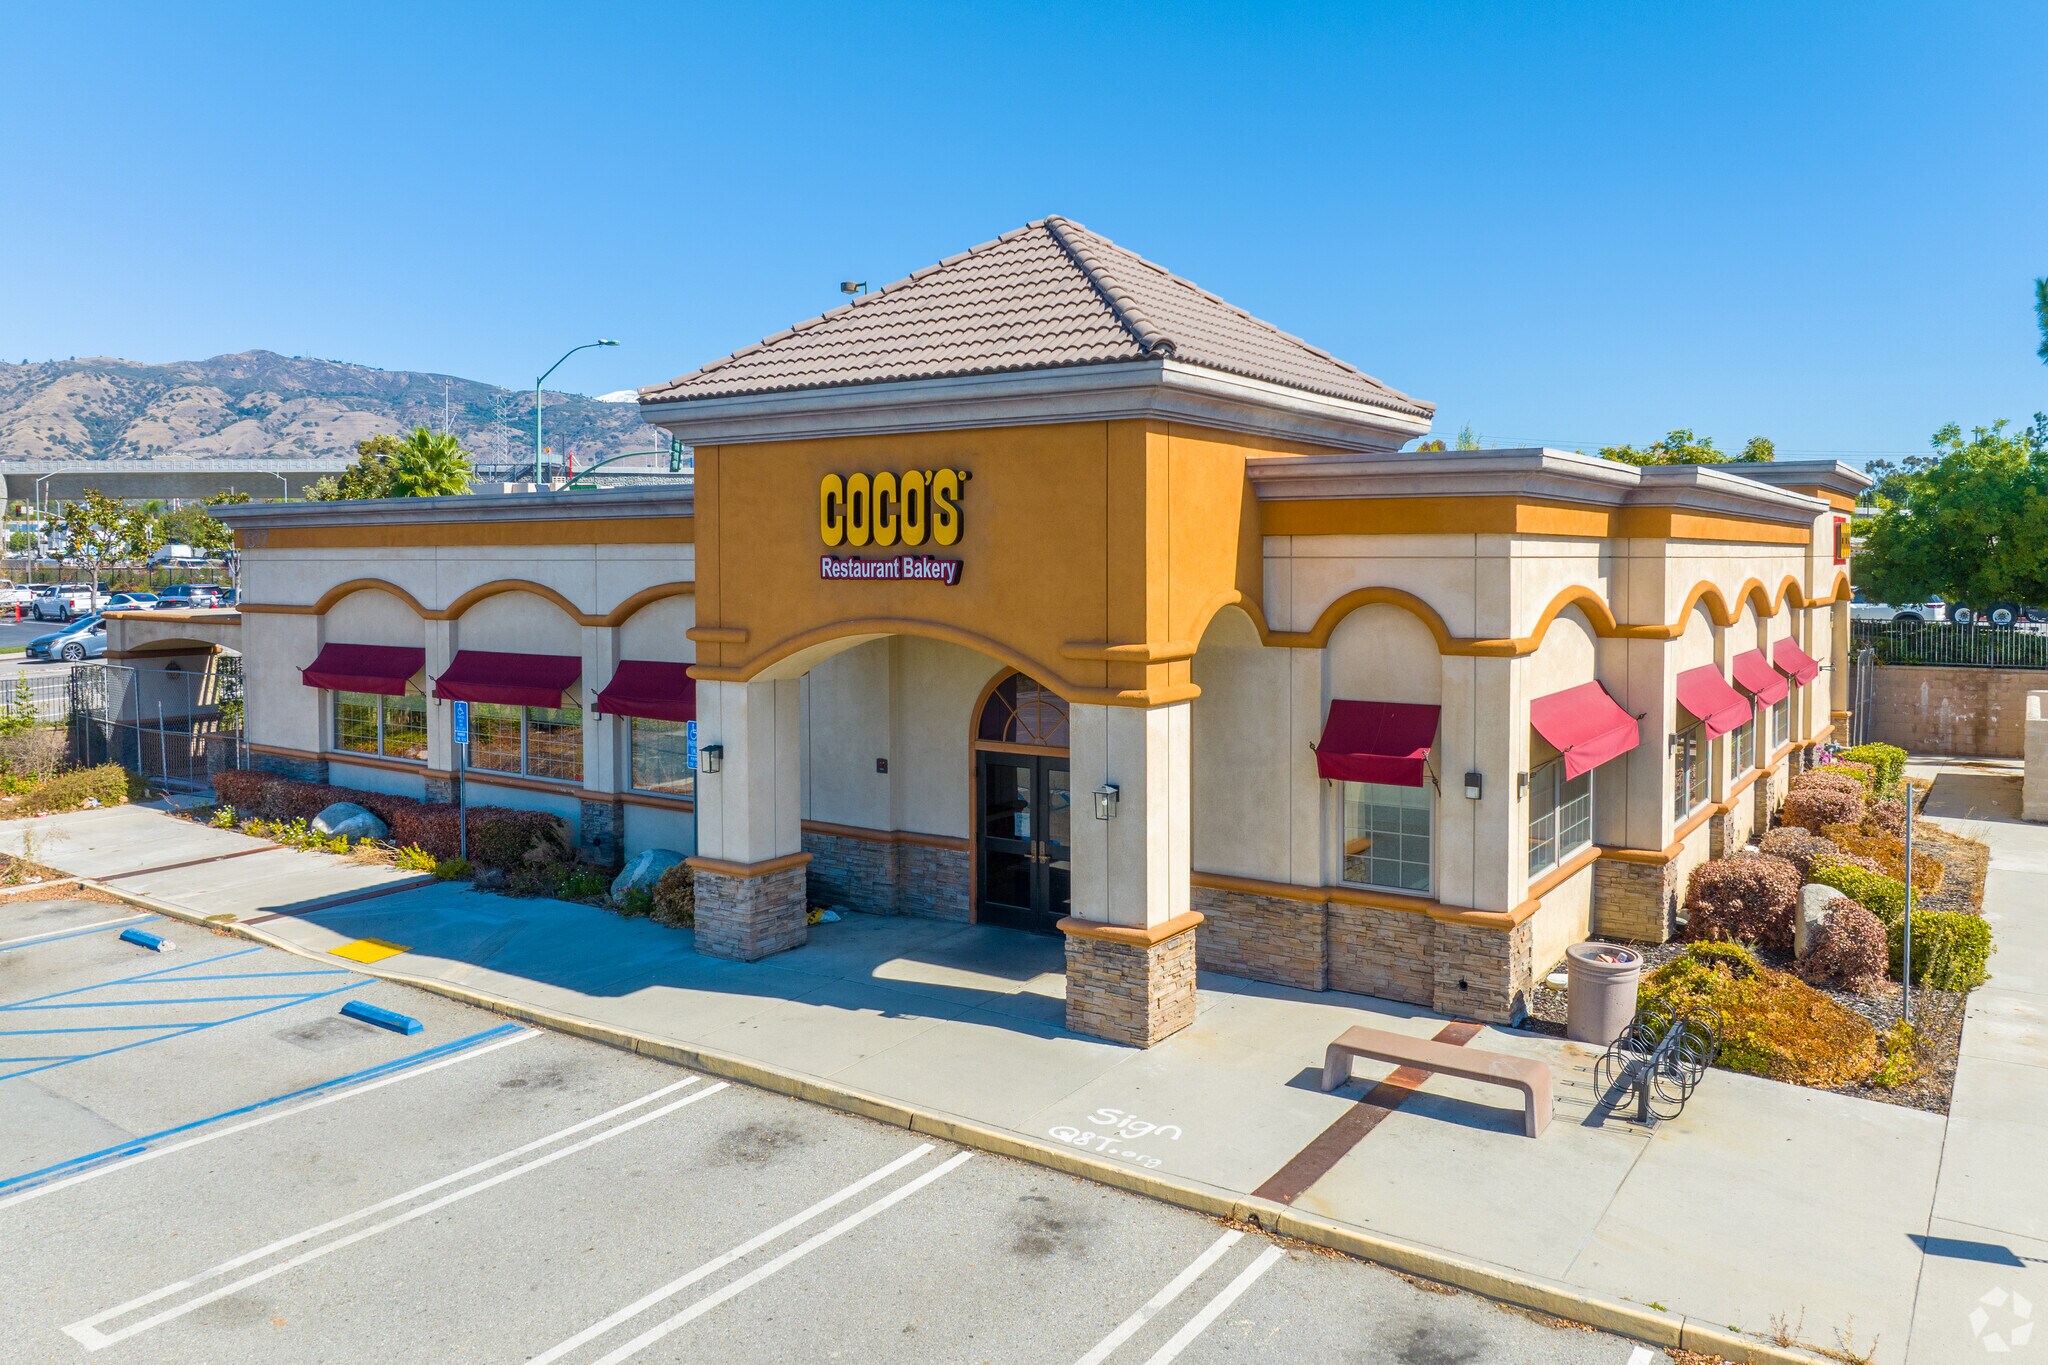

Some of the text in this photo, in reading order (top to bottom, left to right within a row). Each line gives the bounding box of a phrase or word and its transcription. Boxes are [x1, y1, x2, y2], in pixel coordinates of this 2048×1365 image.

[820, 468, 960, 547] COCO'S
[821, 556, 957, 584] Restaurant Bakery
[1087, 1108, 1183, 1141] Sign
